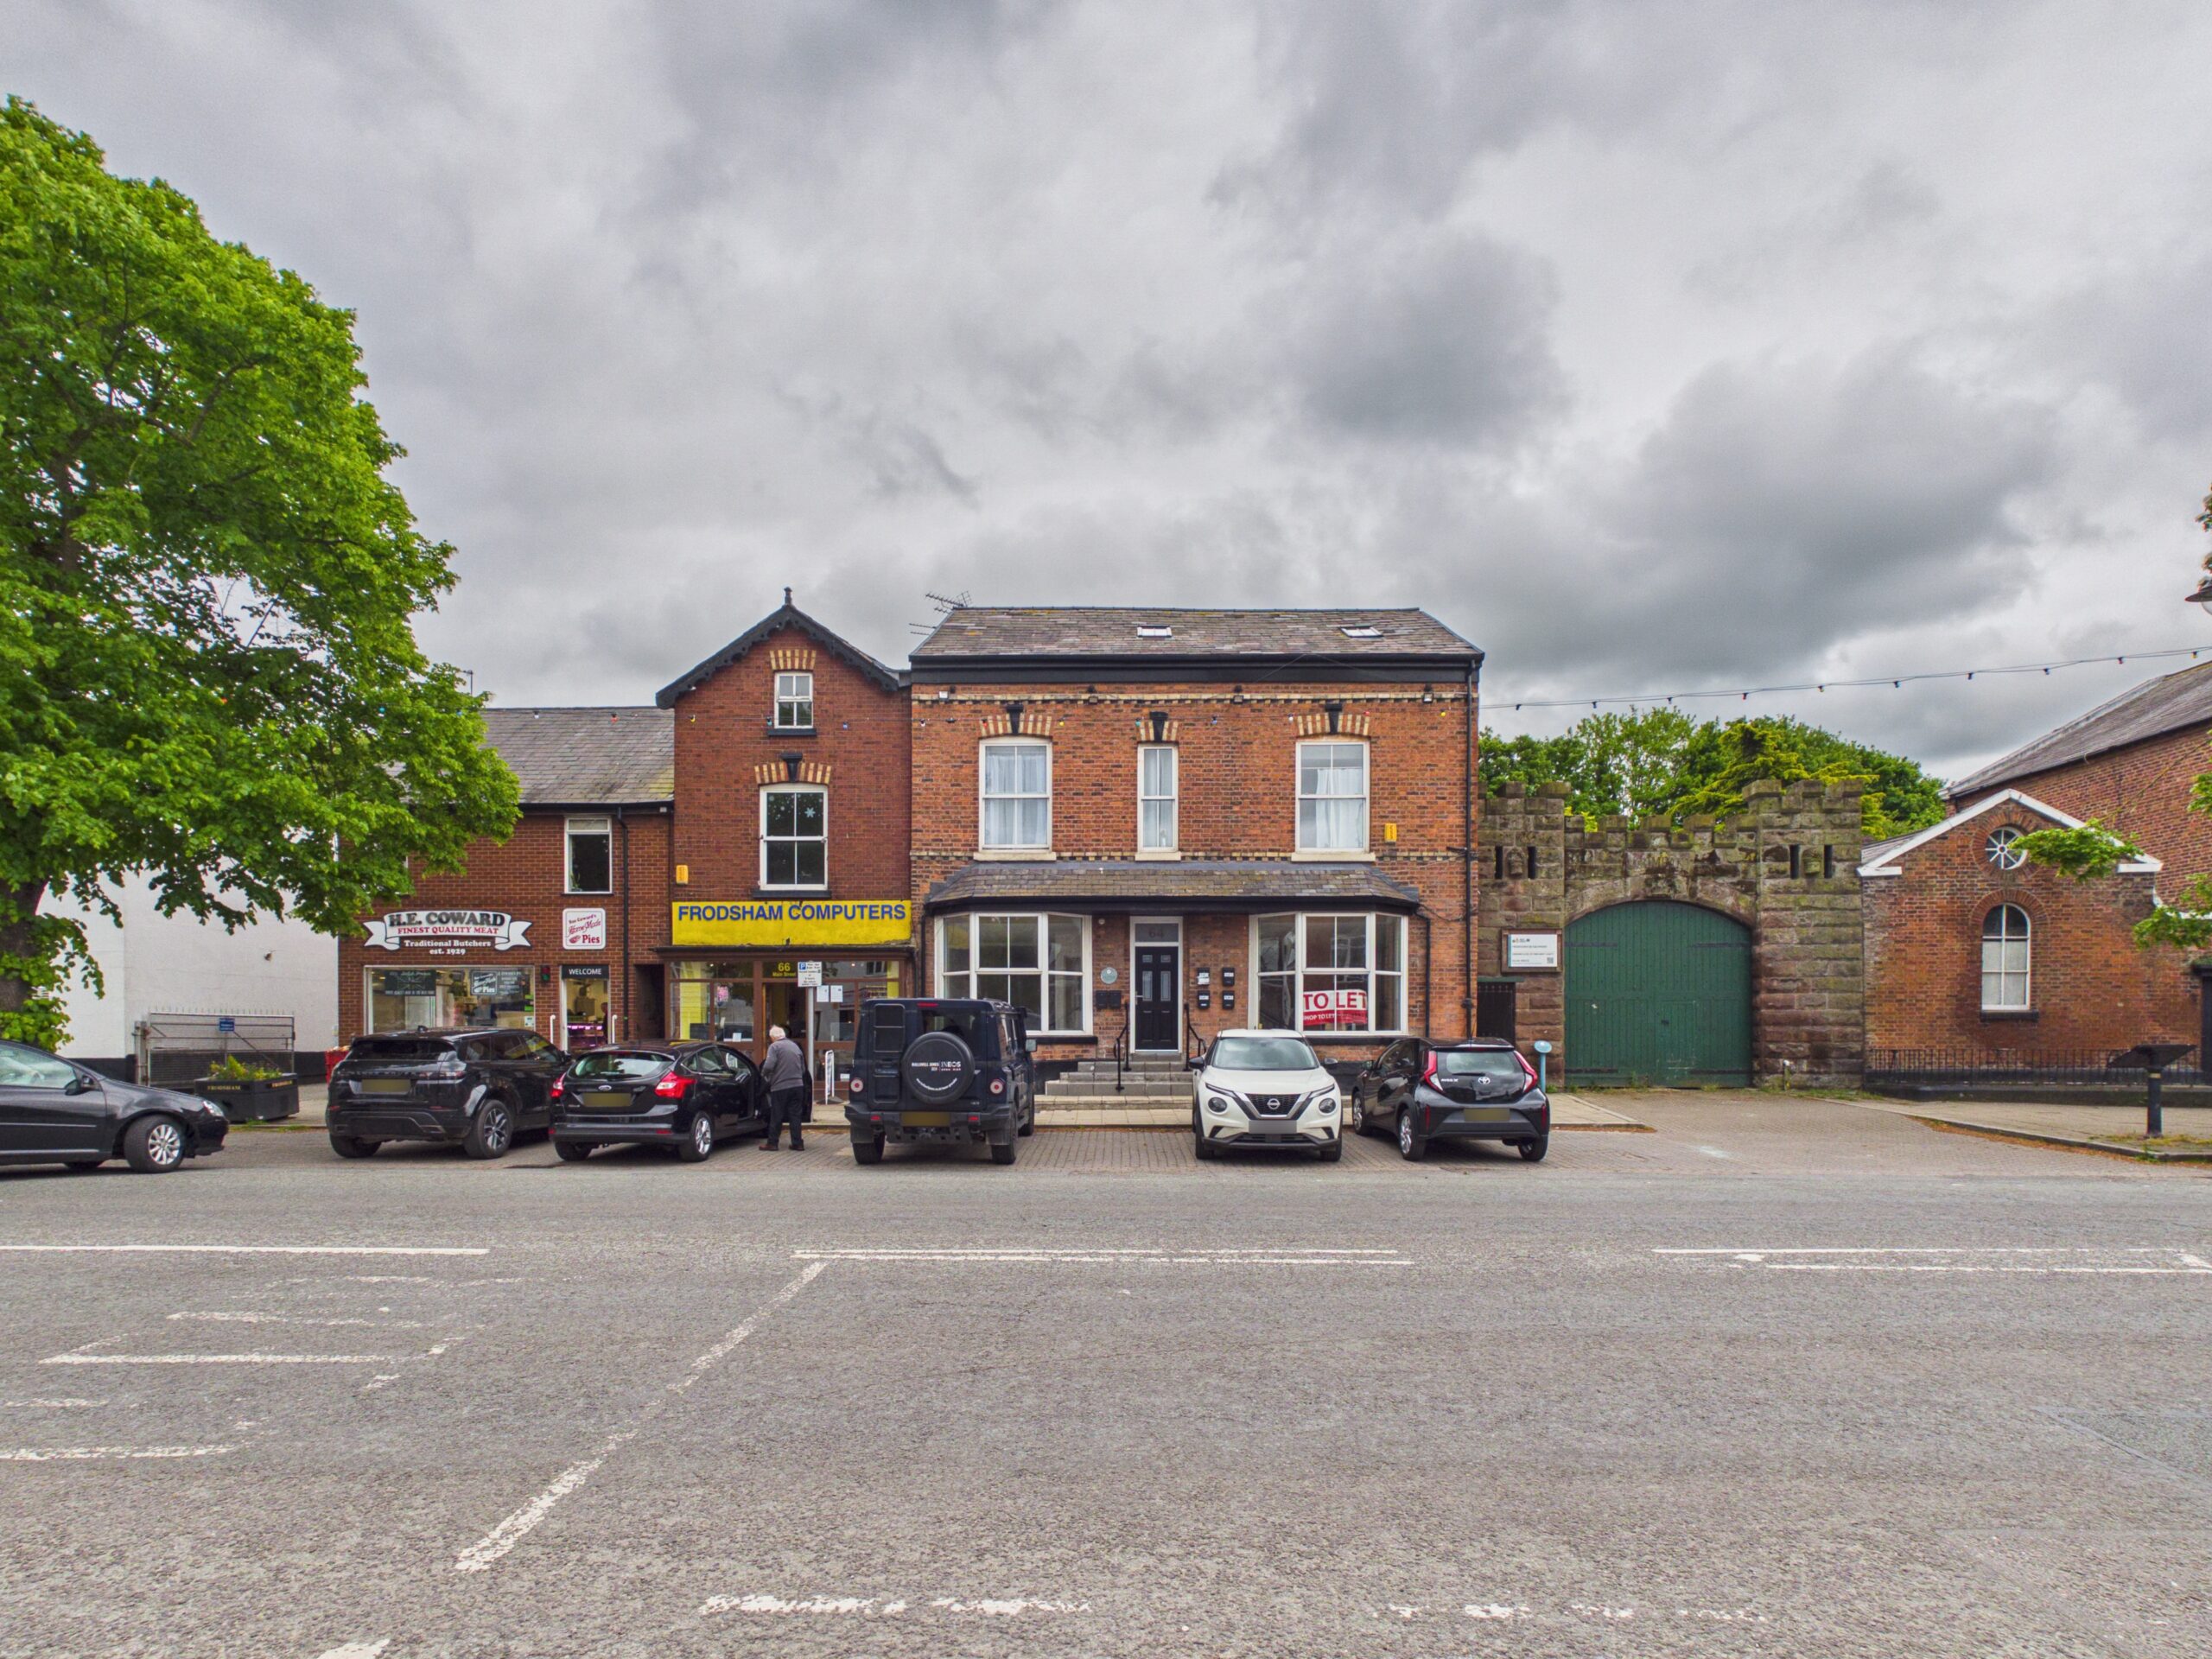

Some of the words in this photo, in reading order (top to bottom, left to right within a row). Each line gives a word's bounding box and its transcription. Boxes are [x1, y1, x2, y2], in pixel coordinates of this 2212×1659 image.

[389, 912, 423, 927] H.E.
[426, 912, 505, 927] COWARD
[678, 905, 783, 921] FRODSHAM
[788, 904, 906, 921] COMPUTERS
[582, 934, 601, 944] Pies
[778, 962, 791, 971] 66
[1303, 993, 1329, 1010] TO
[1336, 991, 1366, 1008] LET
